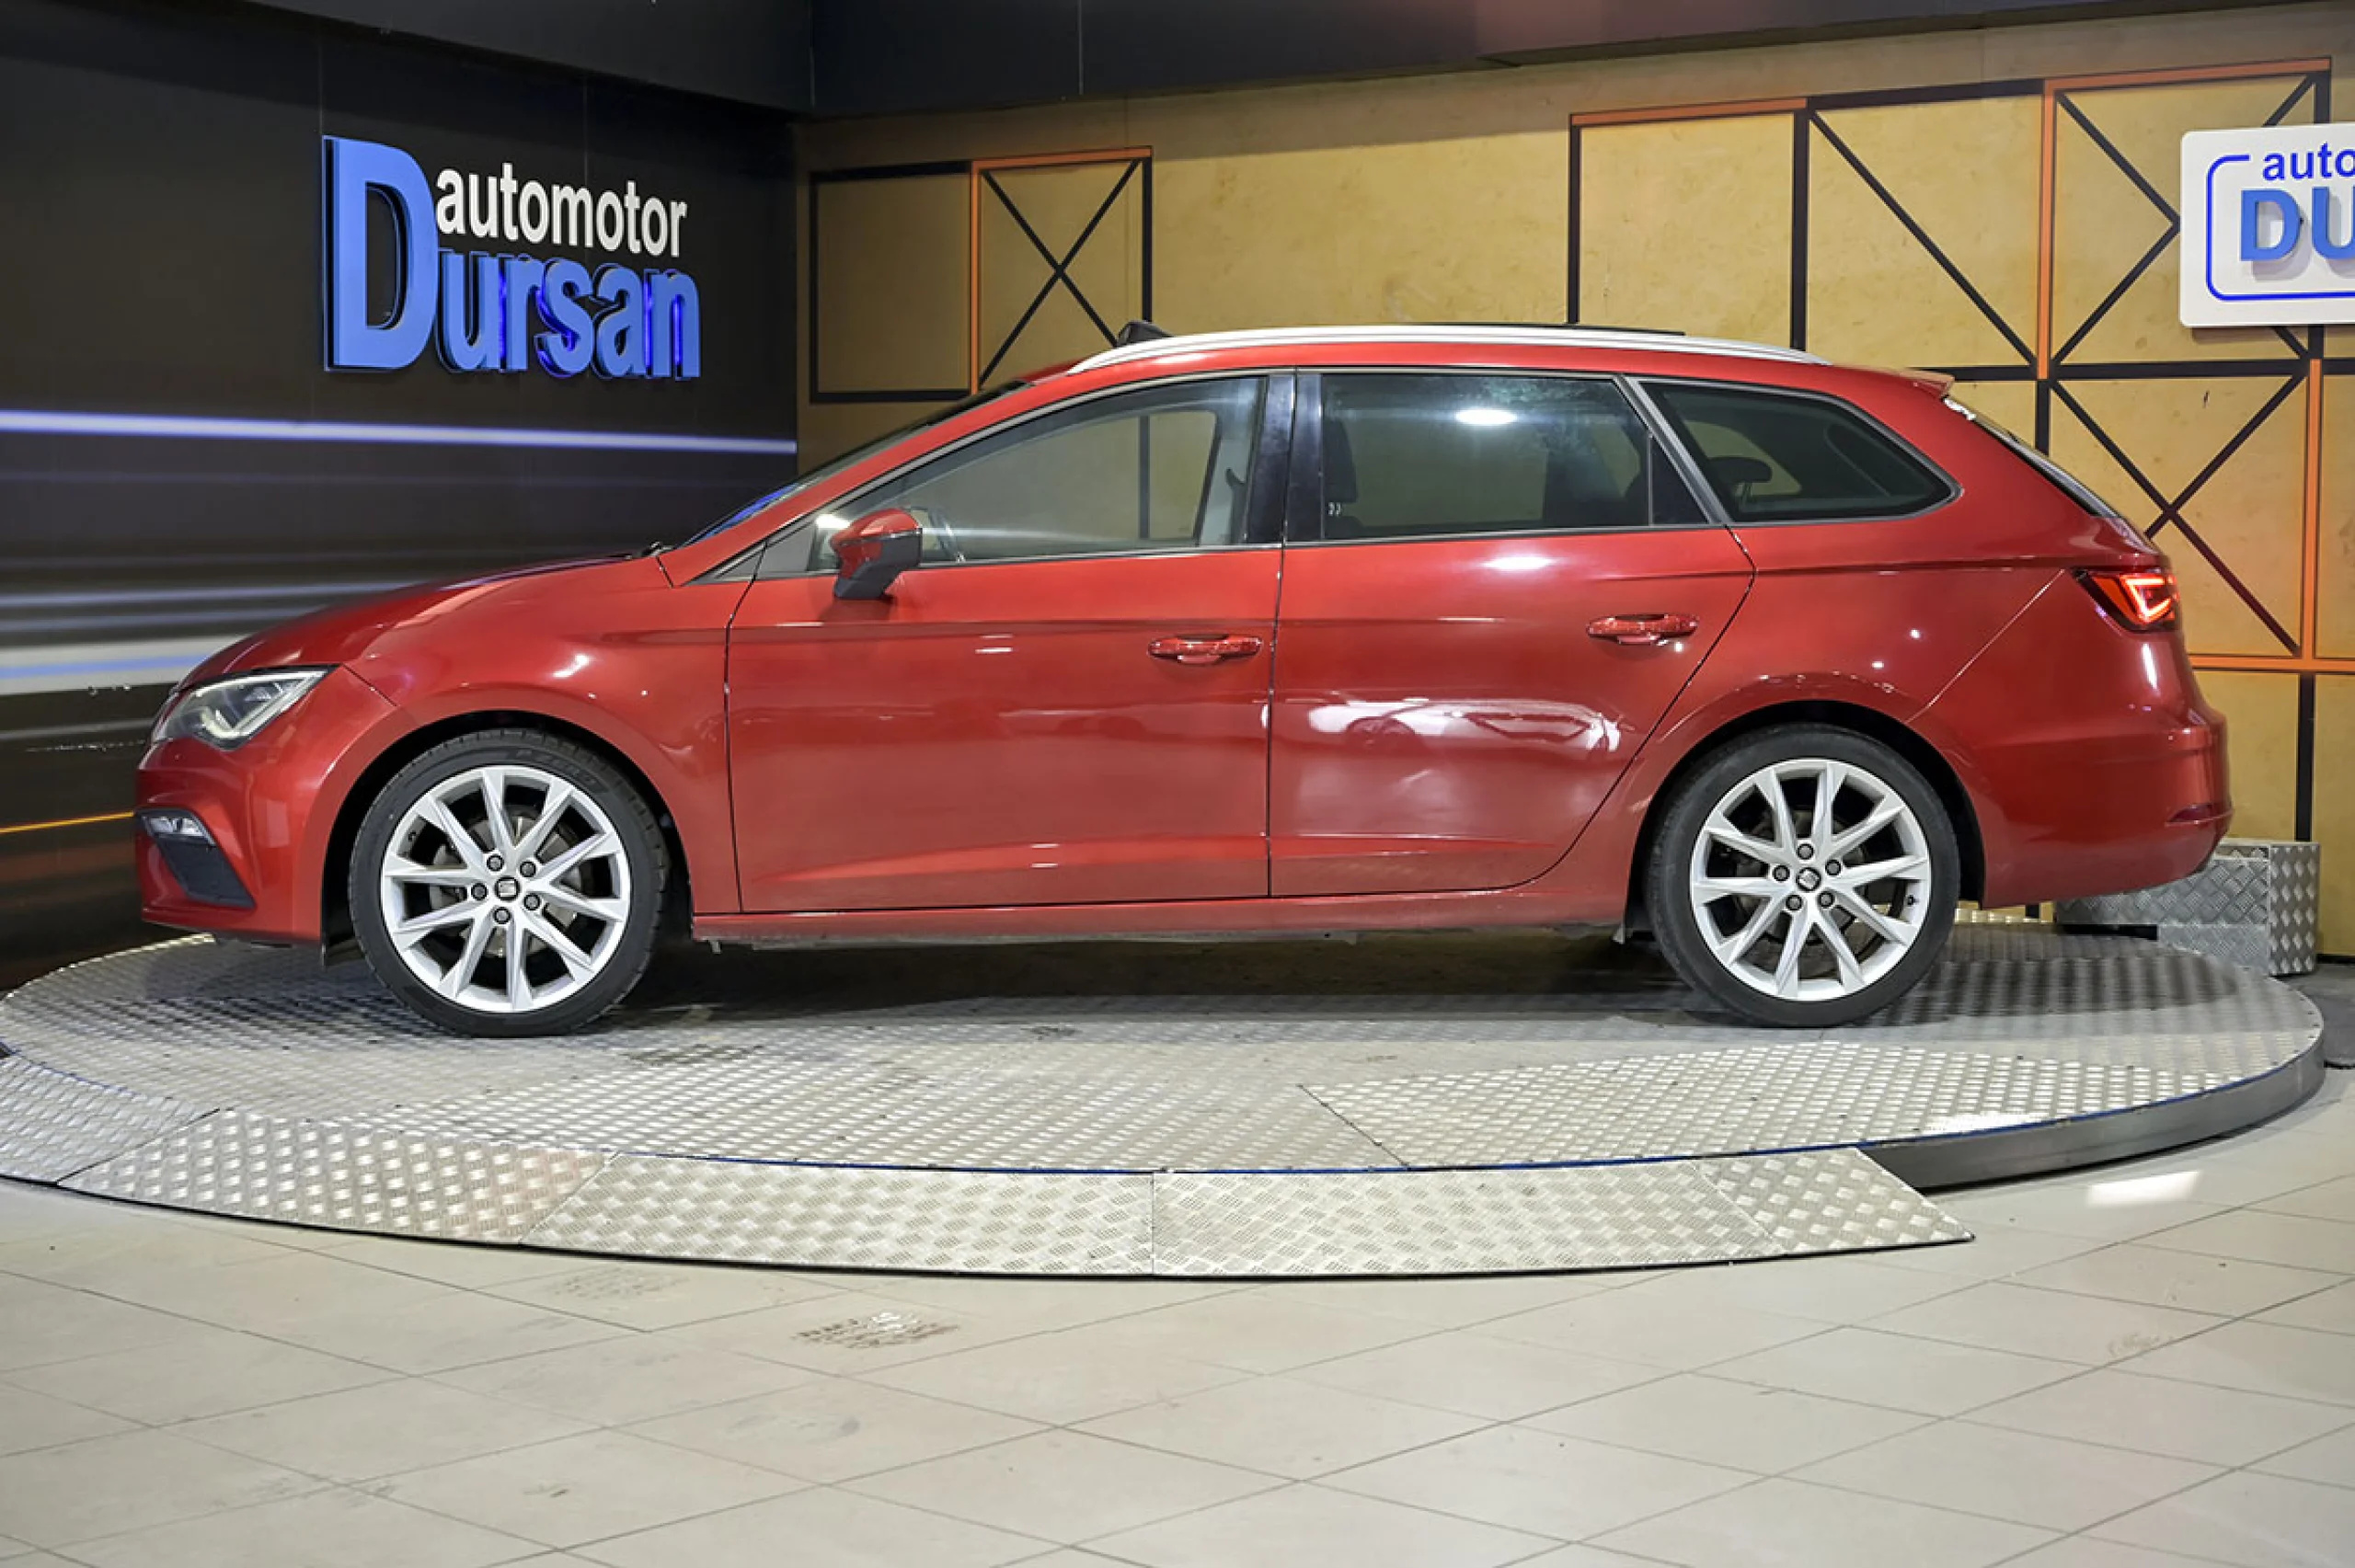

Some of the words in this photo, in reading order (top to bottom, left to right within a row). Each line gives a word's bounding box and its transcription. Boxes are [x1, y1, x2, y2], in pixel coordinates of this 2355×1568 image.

[2262, 141, 2355, 181] auto
[436, 162, 688, 258] automotor
[2240, 186, 2355, 262] DU
[322, 134, 702, 380] Dursan
